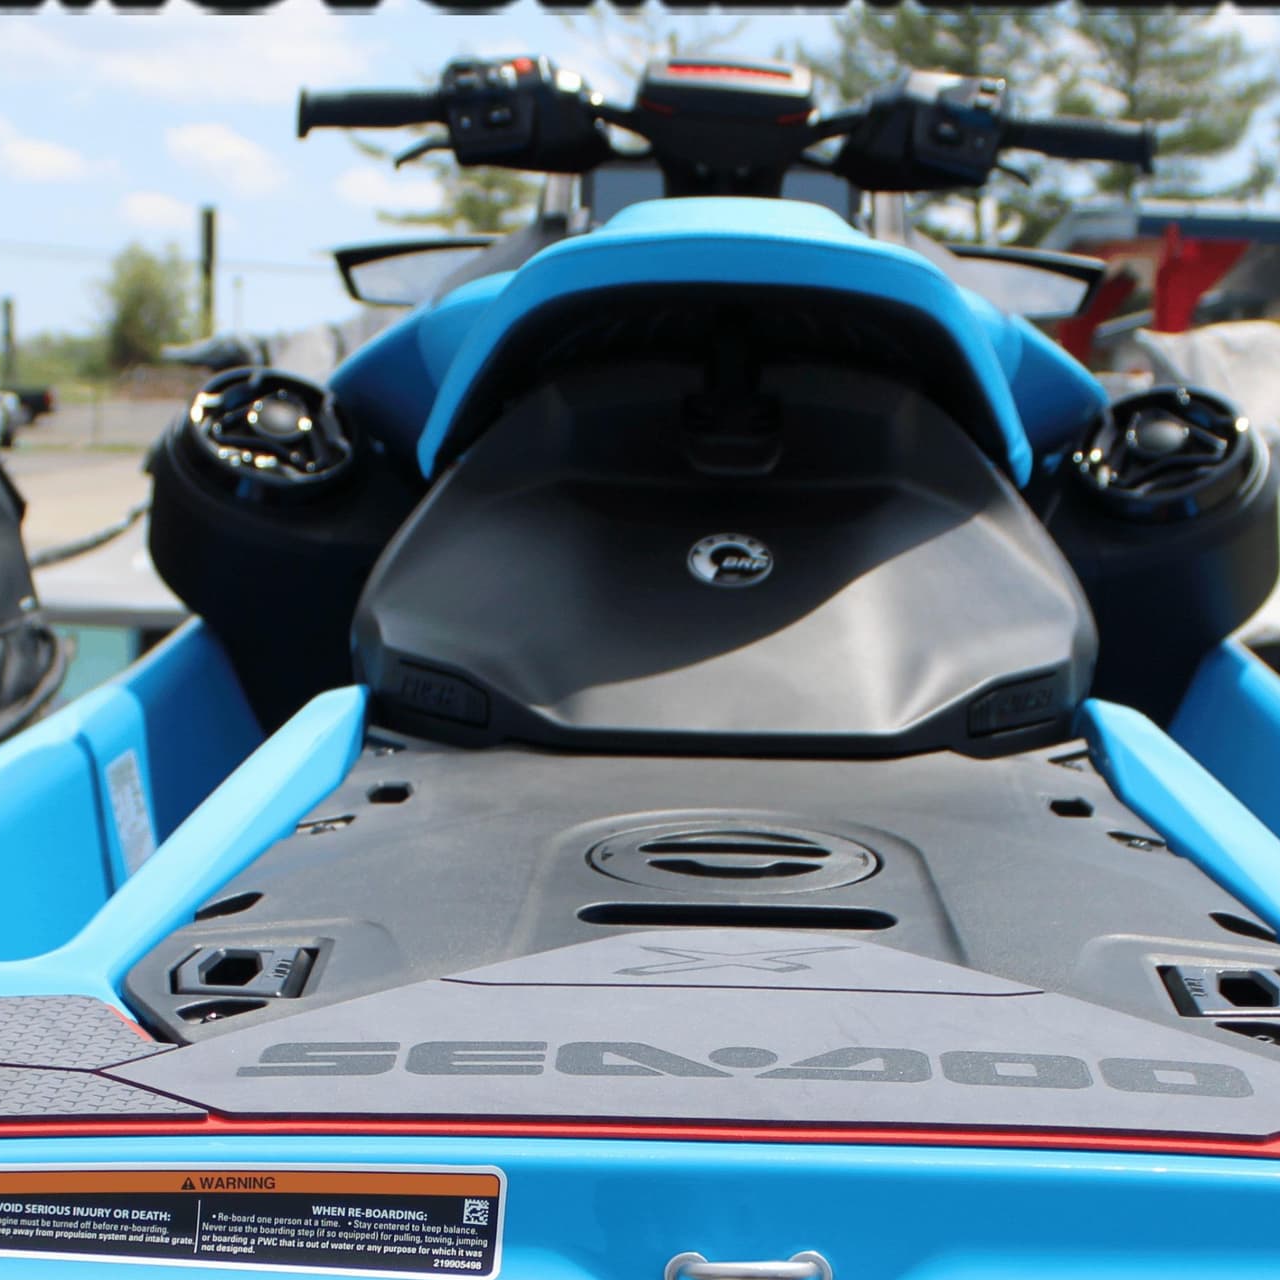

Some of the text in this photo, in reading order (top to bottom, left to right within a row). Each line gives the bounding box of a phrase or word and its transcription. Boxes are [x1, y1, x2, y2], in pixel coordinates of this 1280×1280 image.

[198, 1175, 276, 1190] WARNING
[24, 1203, 71, 1215] SERIOUS
[72, 1206, 111, 1217] INJURY
[112, 1209, 129, 1219] OR
[130, 1210, 171, 1221] DEATH:
[217, 1212, 255, 1222] Re-board
[256, 1215, 272, 1223] one
[273, 1216, 302, 1226] person
[303, 1217, 313, 1225] at
[320, 1219, 340, 1227] time.
[311, 1205, 428, 1221] WHEN RE-BOARDING:
[19, 1217, 39, 1225] must
[40, 1218, 50, 1226] be
[52, 1219, 78, 1228] turned
[79, 1220, 91, 1229] off
[92, 1221, 119, 1230] before
[119, 1222, 169, 1234] re-boarding.
[352, 1219, 371, 1230] Stay
[373, 1221, 409, 1231] centered
[421, 1223, 441, 1234] keep
[443, 1224, 478, 1234] balance.
[12, 1228, 33, 1237] away
[34, 1228, 54, 1237] from
[54, 1229, 97, 1240] propulsion
[98, 1232, 126, 1242] system
[128, 1233, 143, 1241] and
[144, 1234, 170, 1243] intake
[171, 1236, 194, 1246] grate.
[201, 1222, 226, 1231] Never
[244, 1224, 258, 1233] the
[259, 1225, 295, 1236] boarding
[296, 1228, 314, 1237] step
[316, 1228, 325, 1237] (if
[337, 1230, 379, 1241] equipped)
[380, 1231, 392, 1240] for
[392, 1232, 422, 1244] pulling,
[424, 1235, 454, 1245] towing,
[455, 1236, 488, 1248] jumping
[200, 1243, 255, 1255] not designed.
[212, 1234, 247, 1245] boarding
[257, 1237, 278, 1246] PWC
[278, 1238, 295, 1247] that
[296, 1239, 304, 1247] is
[305, 1240, 319, 1248] out
[320, 1240, 329, 1249] of
[330, 1241, 354, 1250] water
[366, 1244, 382, 1253] any
[383, 1245, 416, 1254] purpose
[418, 1246, 430, 1254] for
[431, 1247, 456, 1256] which
[457, 1248, 464, 1256] it
